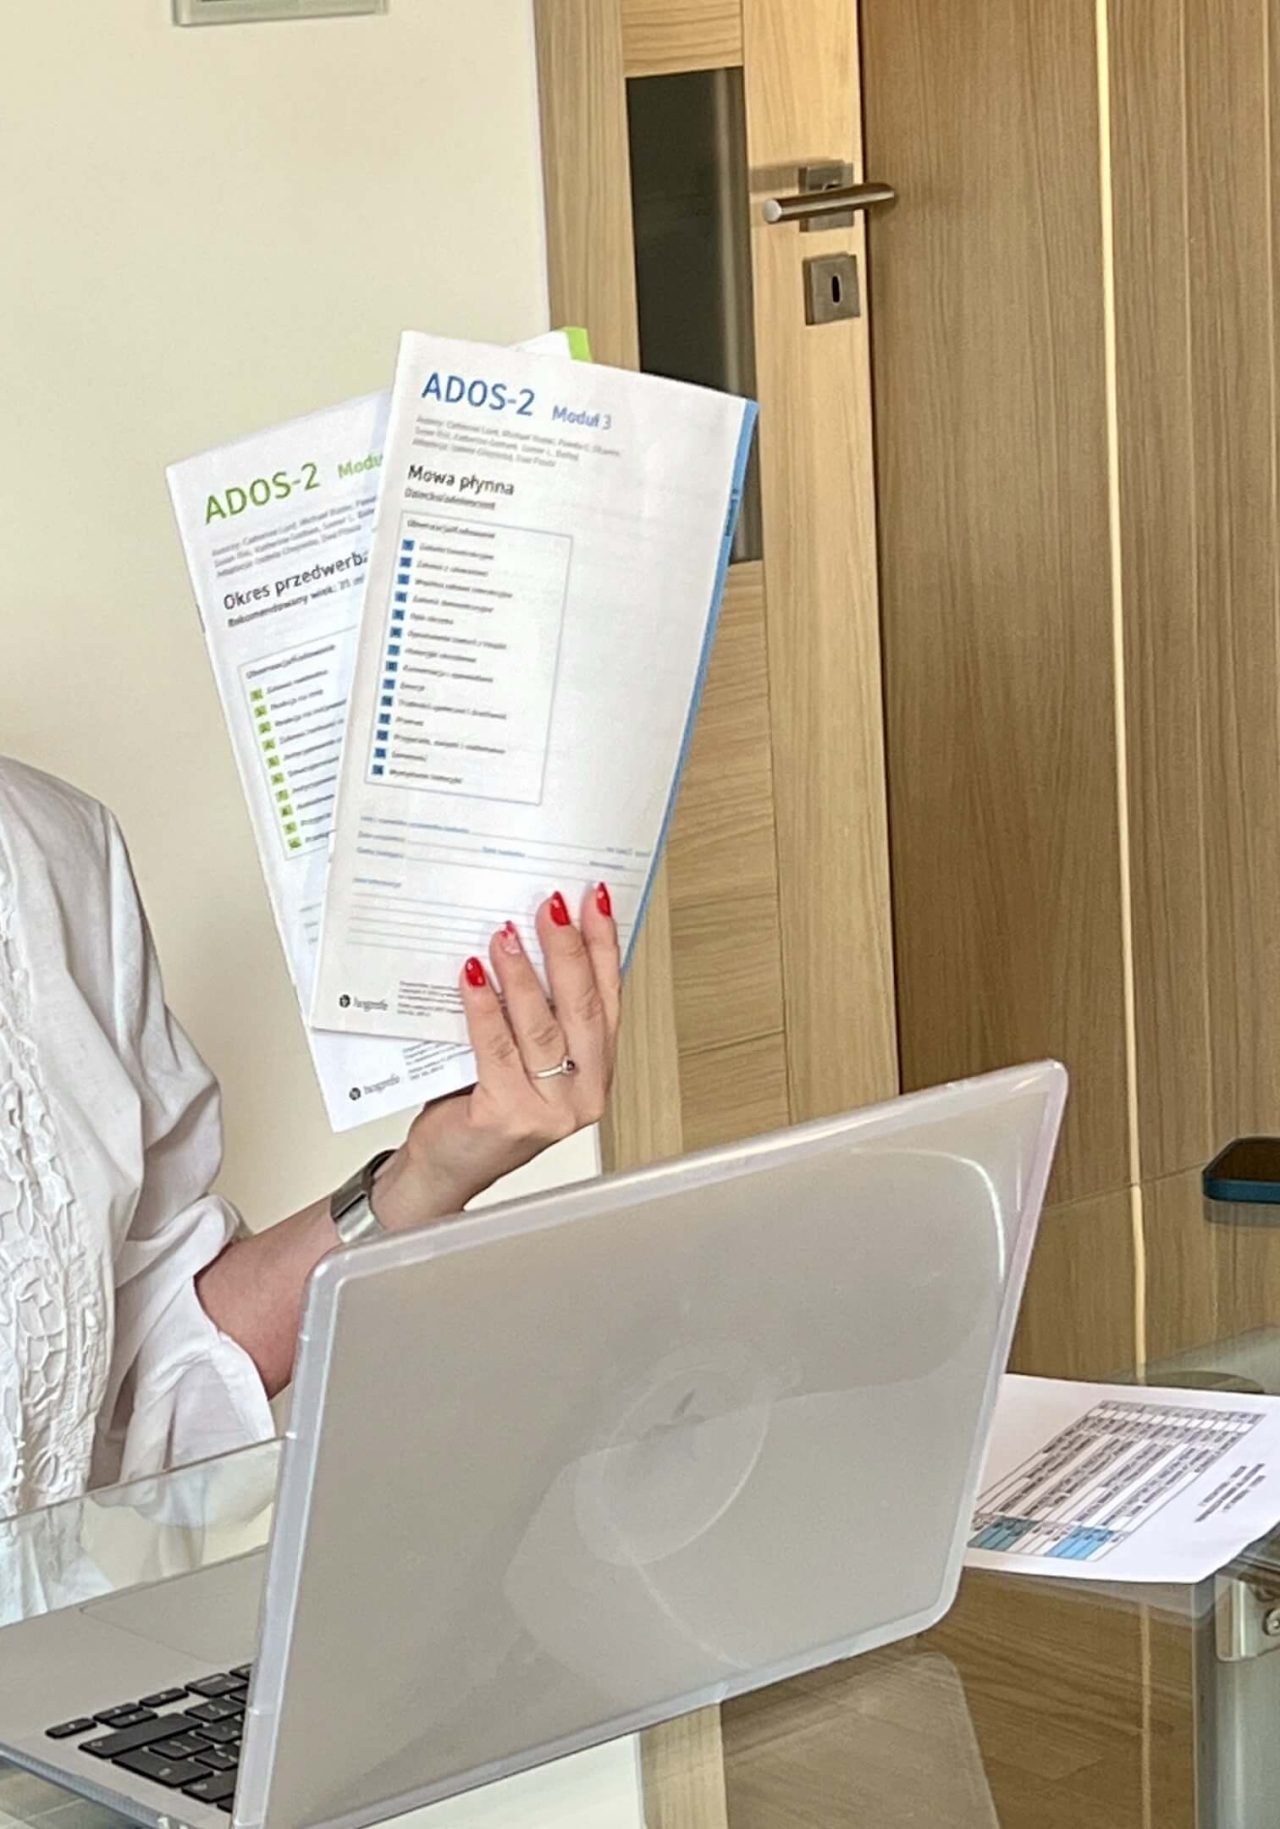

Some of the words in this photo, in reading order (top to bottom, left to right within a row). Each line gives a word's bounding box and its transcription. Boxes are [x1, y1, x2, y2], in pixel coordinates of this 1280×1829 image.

[421, 372, 536, 417] ADOS-2
[551, 403, 601, 427] Moduł
[603, 414, 613, 430] 3
[204, 462, 321, 525] ADOS-2
[337, 453, 383, 479] Modu
[407, 464, 455, 485] Mowa
[459, 473, 515, 495] płynna
[223, 584, 271, 611] Okres
